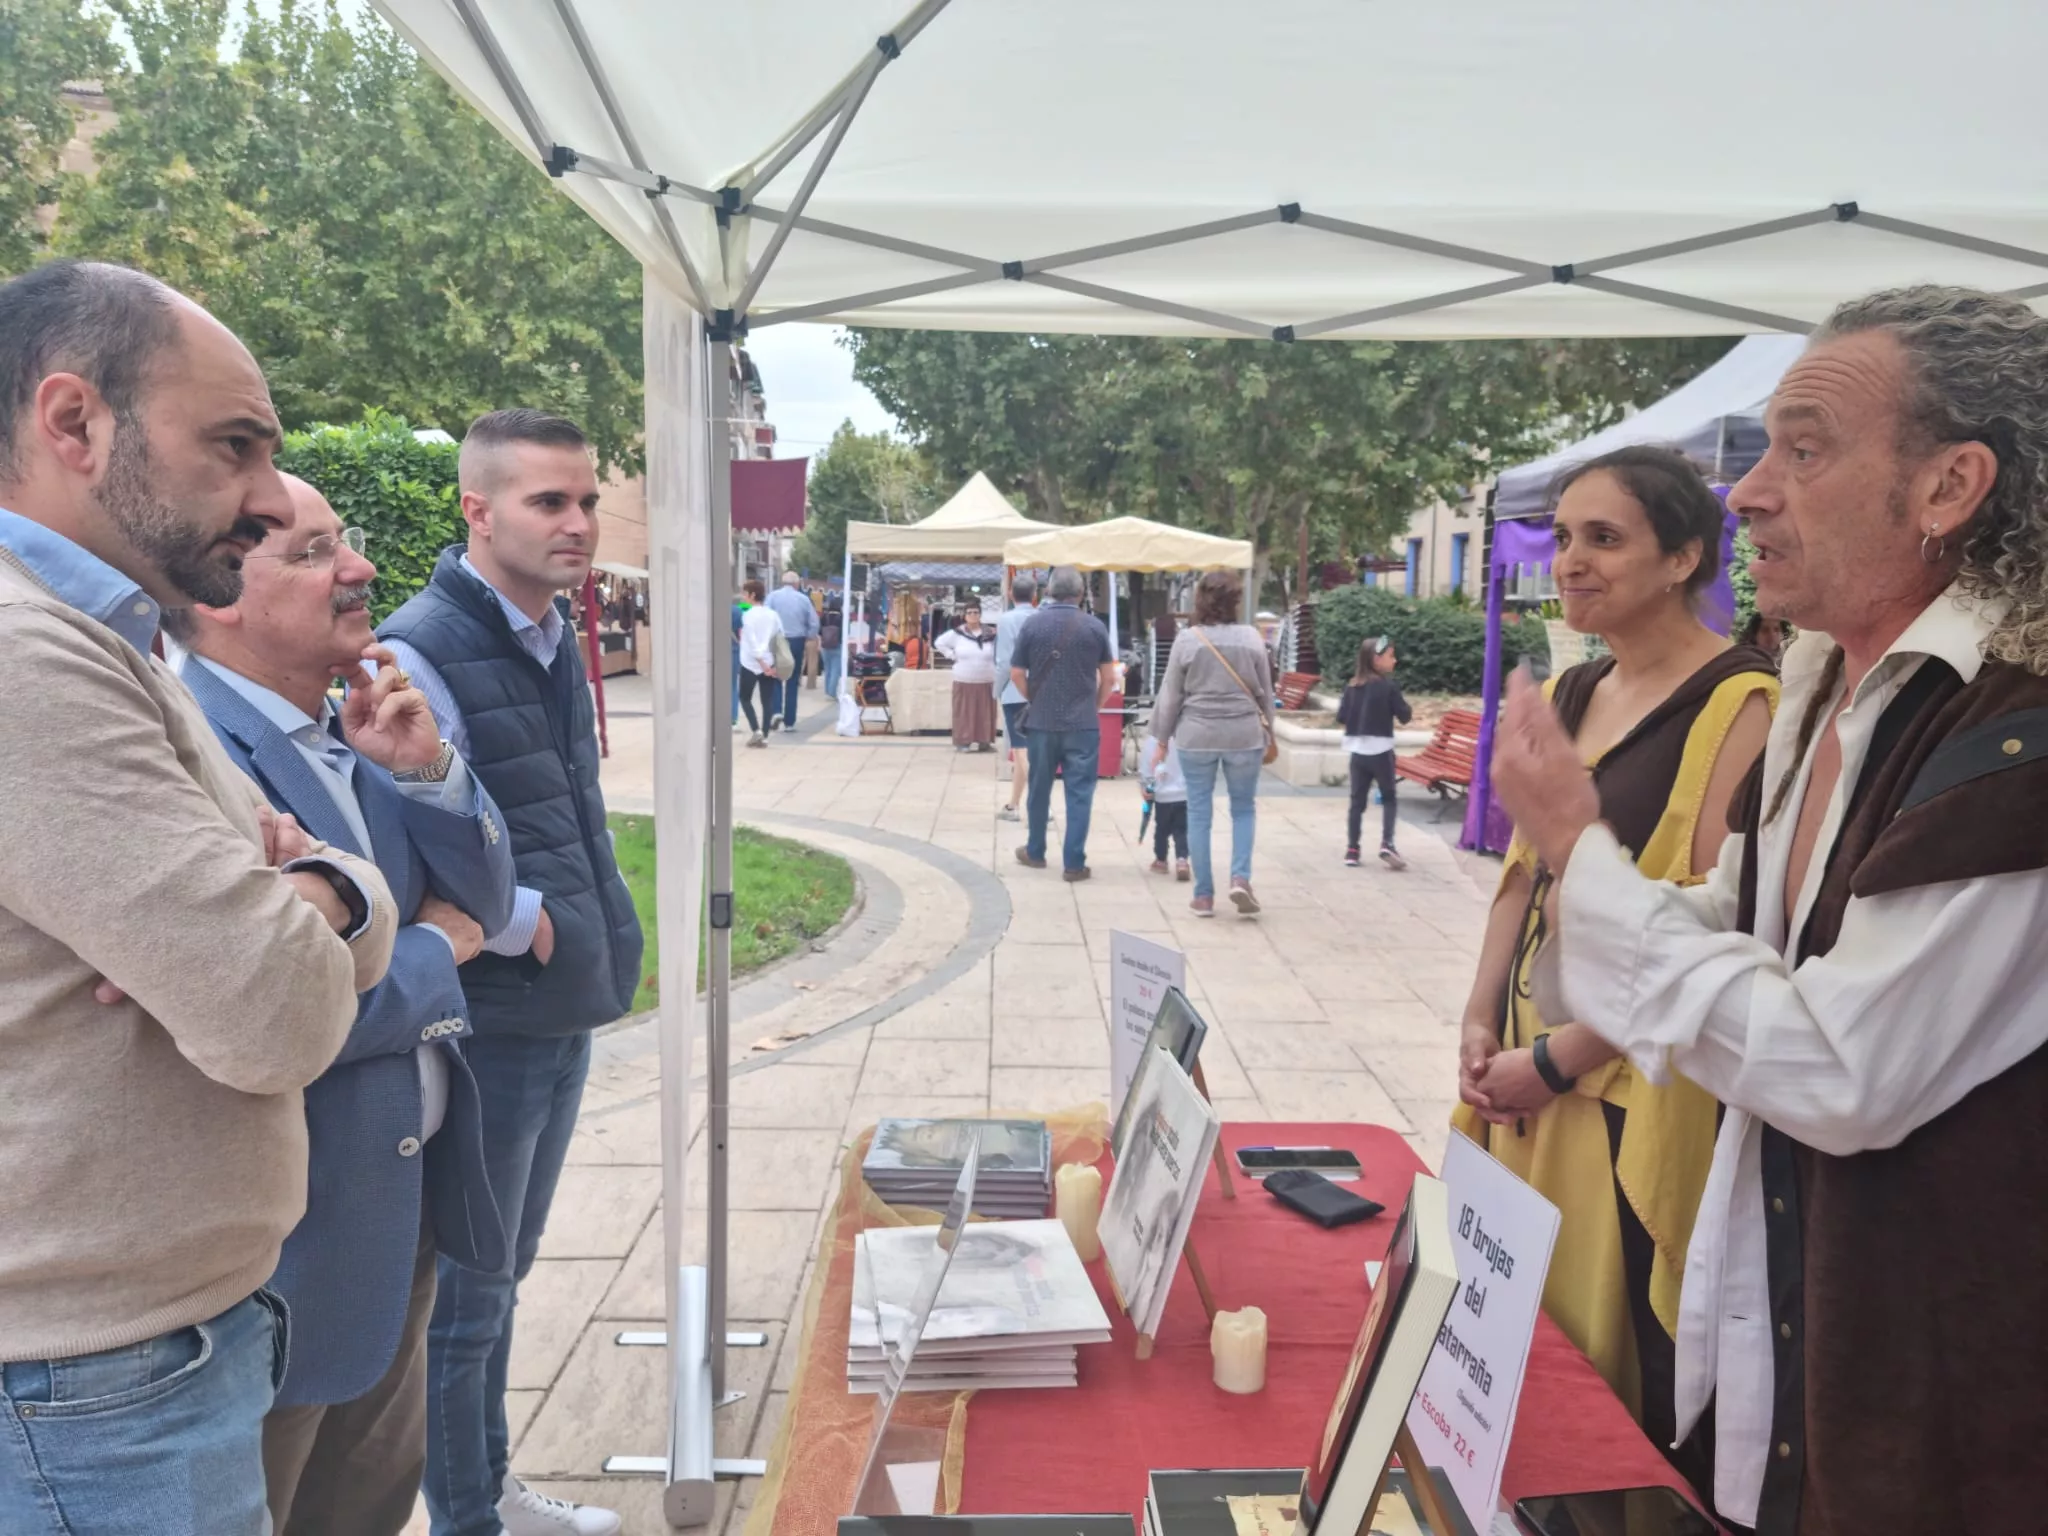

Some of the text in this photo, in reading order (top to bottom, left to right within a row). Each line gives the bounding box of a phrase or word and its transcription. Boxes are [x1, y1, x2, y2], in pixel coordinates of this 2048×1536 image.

[1458, 1203, 1514, 1280] 18 brujas
[1464, 1276, 1488, 1319] del
[1437, 1322, 1493, 1398] atarraña
[1421, 1391, 1452, 1439] Escoba
[1454, 1432, 1467, 1459] 22
[1467, 1449, 1476, 1468] €
